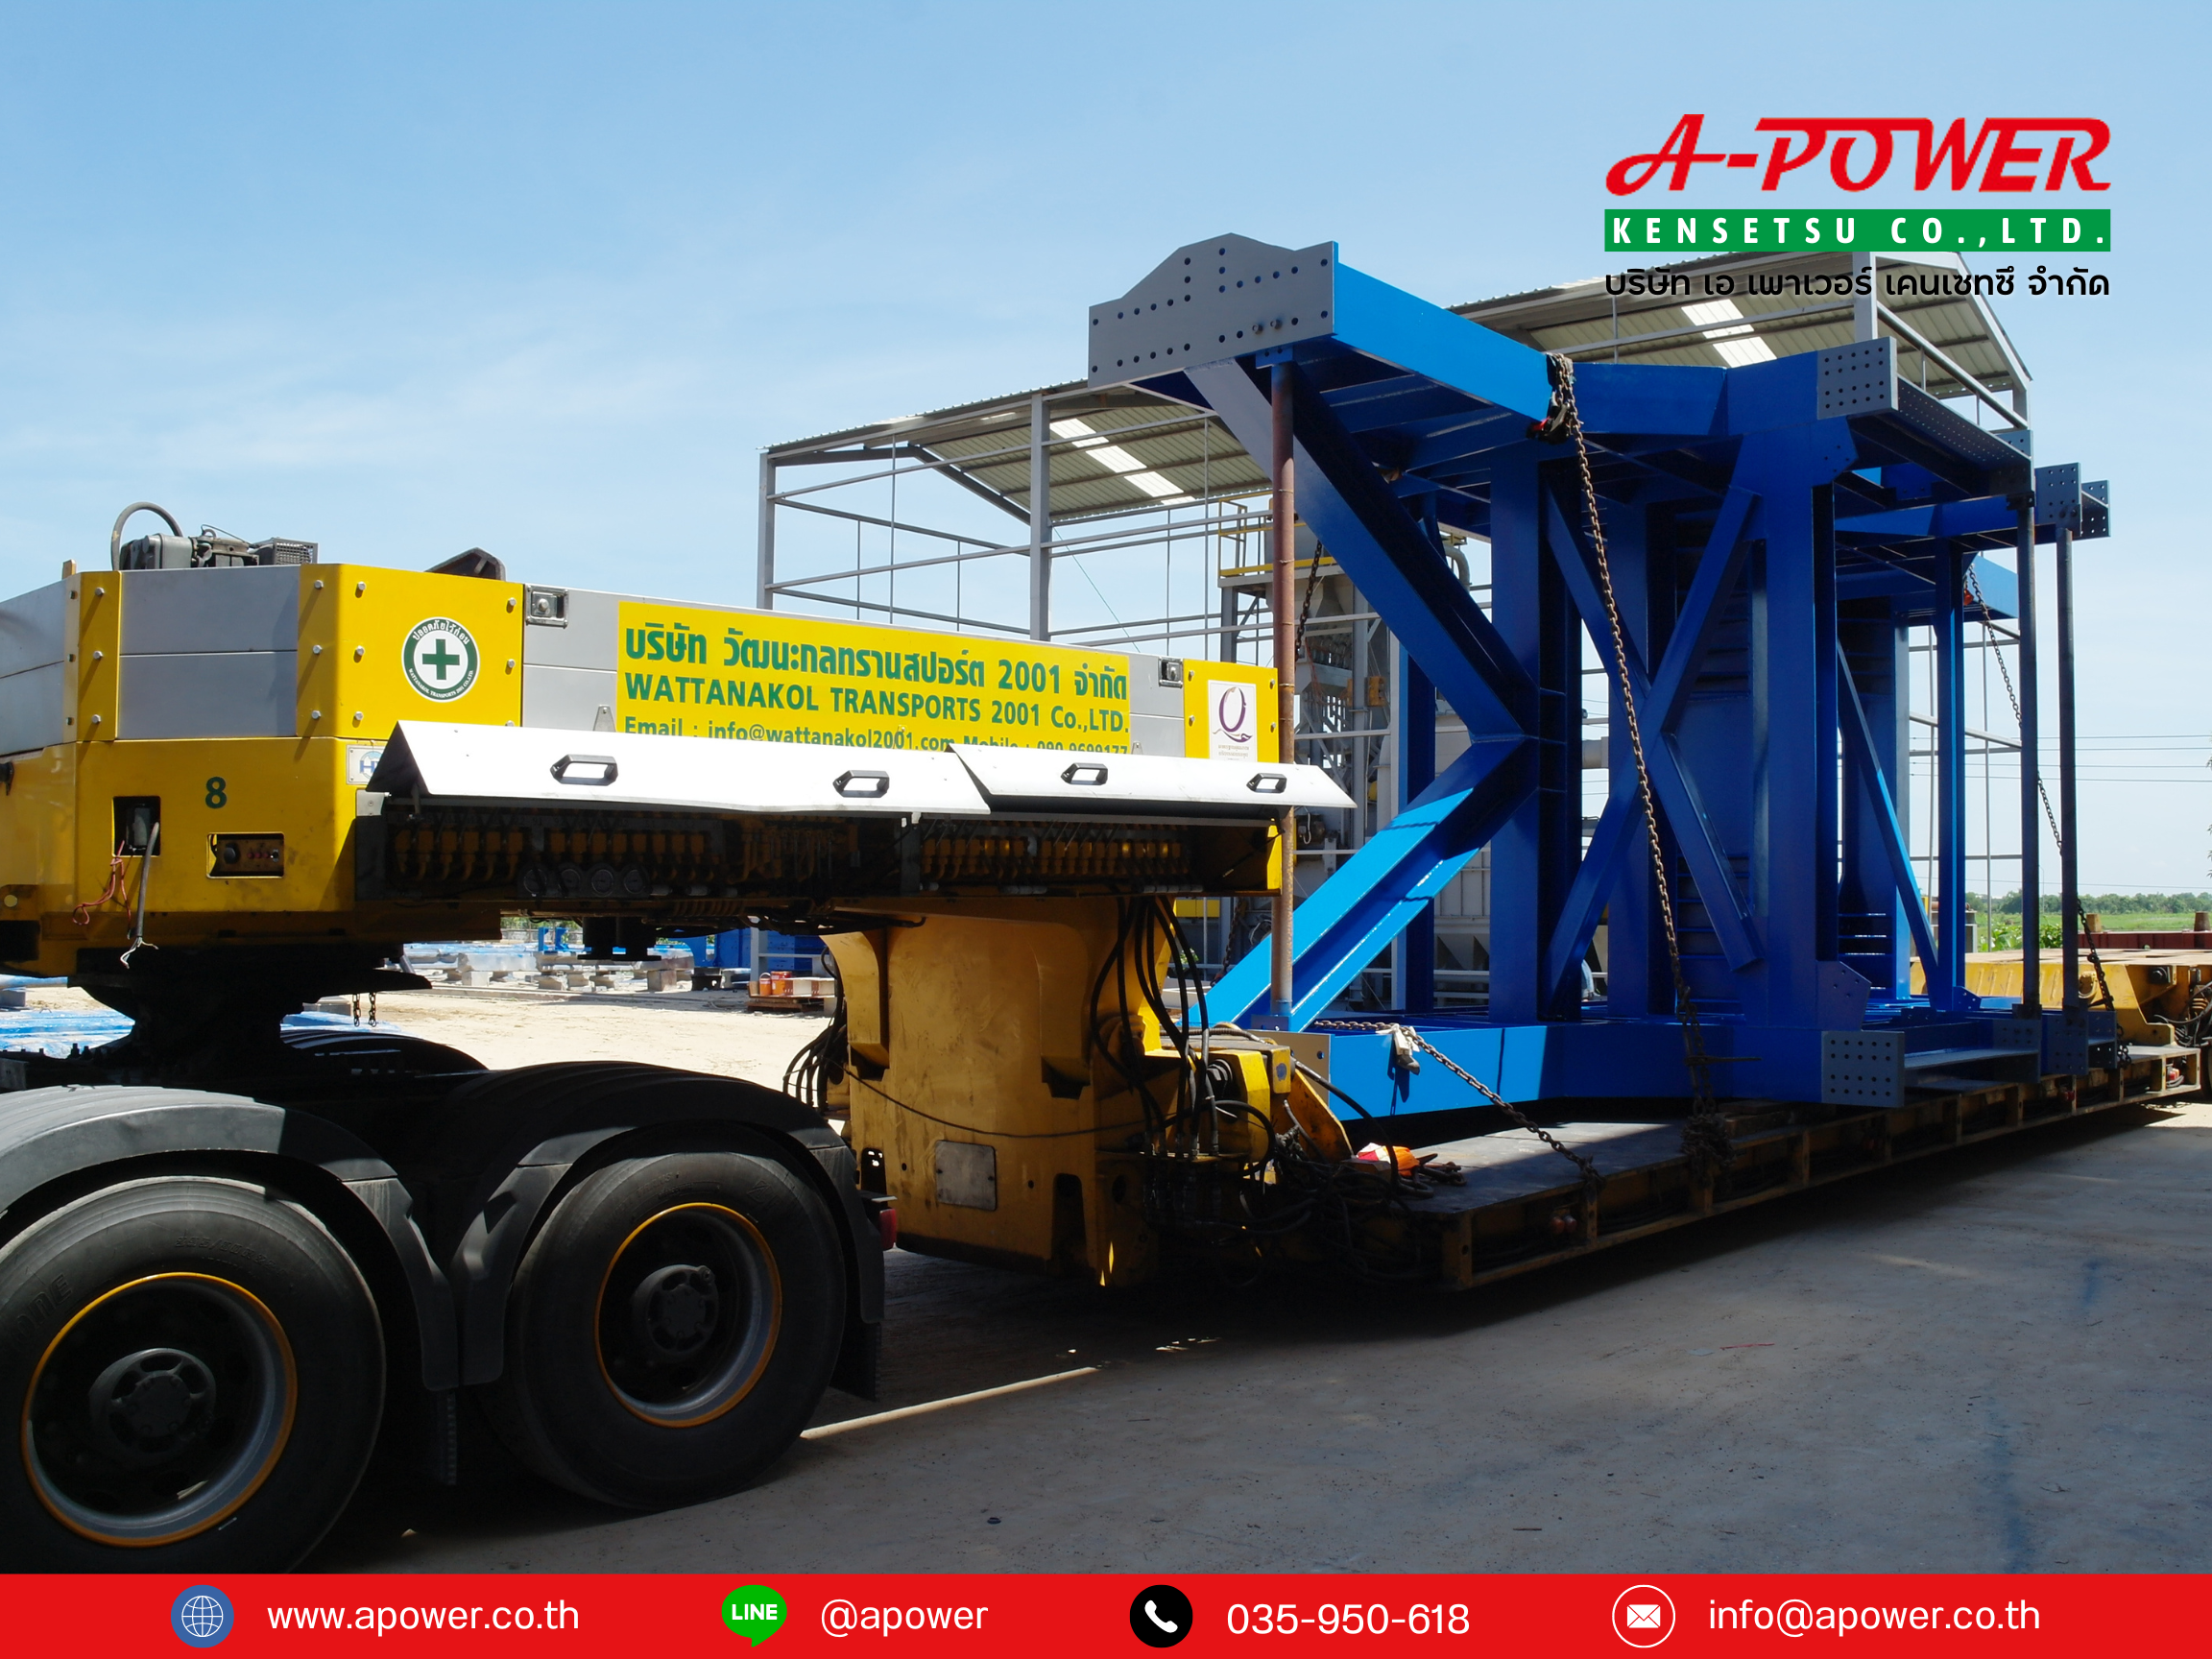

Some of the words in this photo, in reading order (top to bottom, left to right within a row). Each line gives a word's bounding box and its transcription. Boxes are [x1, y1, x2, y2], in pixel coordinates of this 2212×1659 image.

[625, 622, 708, 664] บริษัท
[998, 659, 1060, 694] 2001
[1073, 662, 1128, 700] จำกัด
[625, 672, 819, 710] WATTANAKOL
[830, 687, 981, 722] TRANSPORTS
[991, 700, 1040, 727] 2001
[1050, 706, 1129, 733] Co.,LTD.
[625, 716, 683, 736] Email
[204, 776, 228, 809] 8
